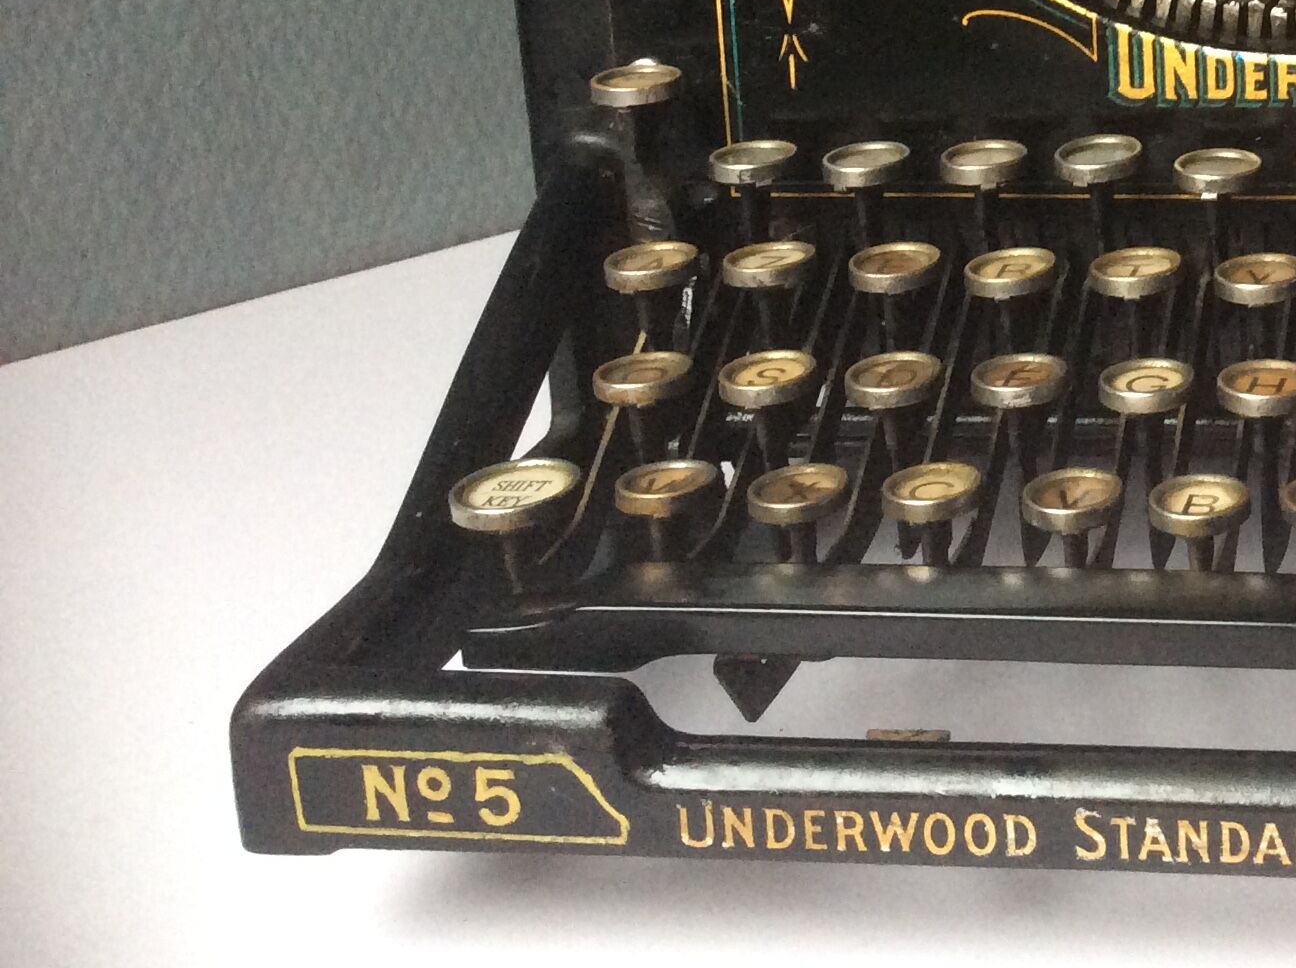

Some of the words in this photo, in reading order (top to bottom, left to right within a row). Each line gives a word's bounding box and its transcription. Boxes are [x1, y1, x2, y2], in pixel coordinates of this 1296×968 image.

[748, 367, 786, 385] S
[1125, 375, 1170, 392] G
[1247, 376, 1287, 394] H
[495, 479, 553, 493] SHIFT
[481, 494, 532, 508] KEY
[1182, 493, 1221, 515] B
[473, 767, 522, 826] 5
[678, 800, 1038, 858] UNDERWOOD
